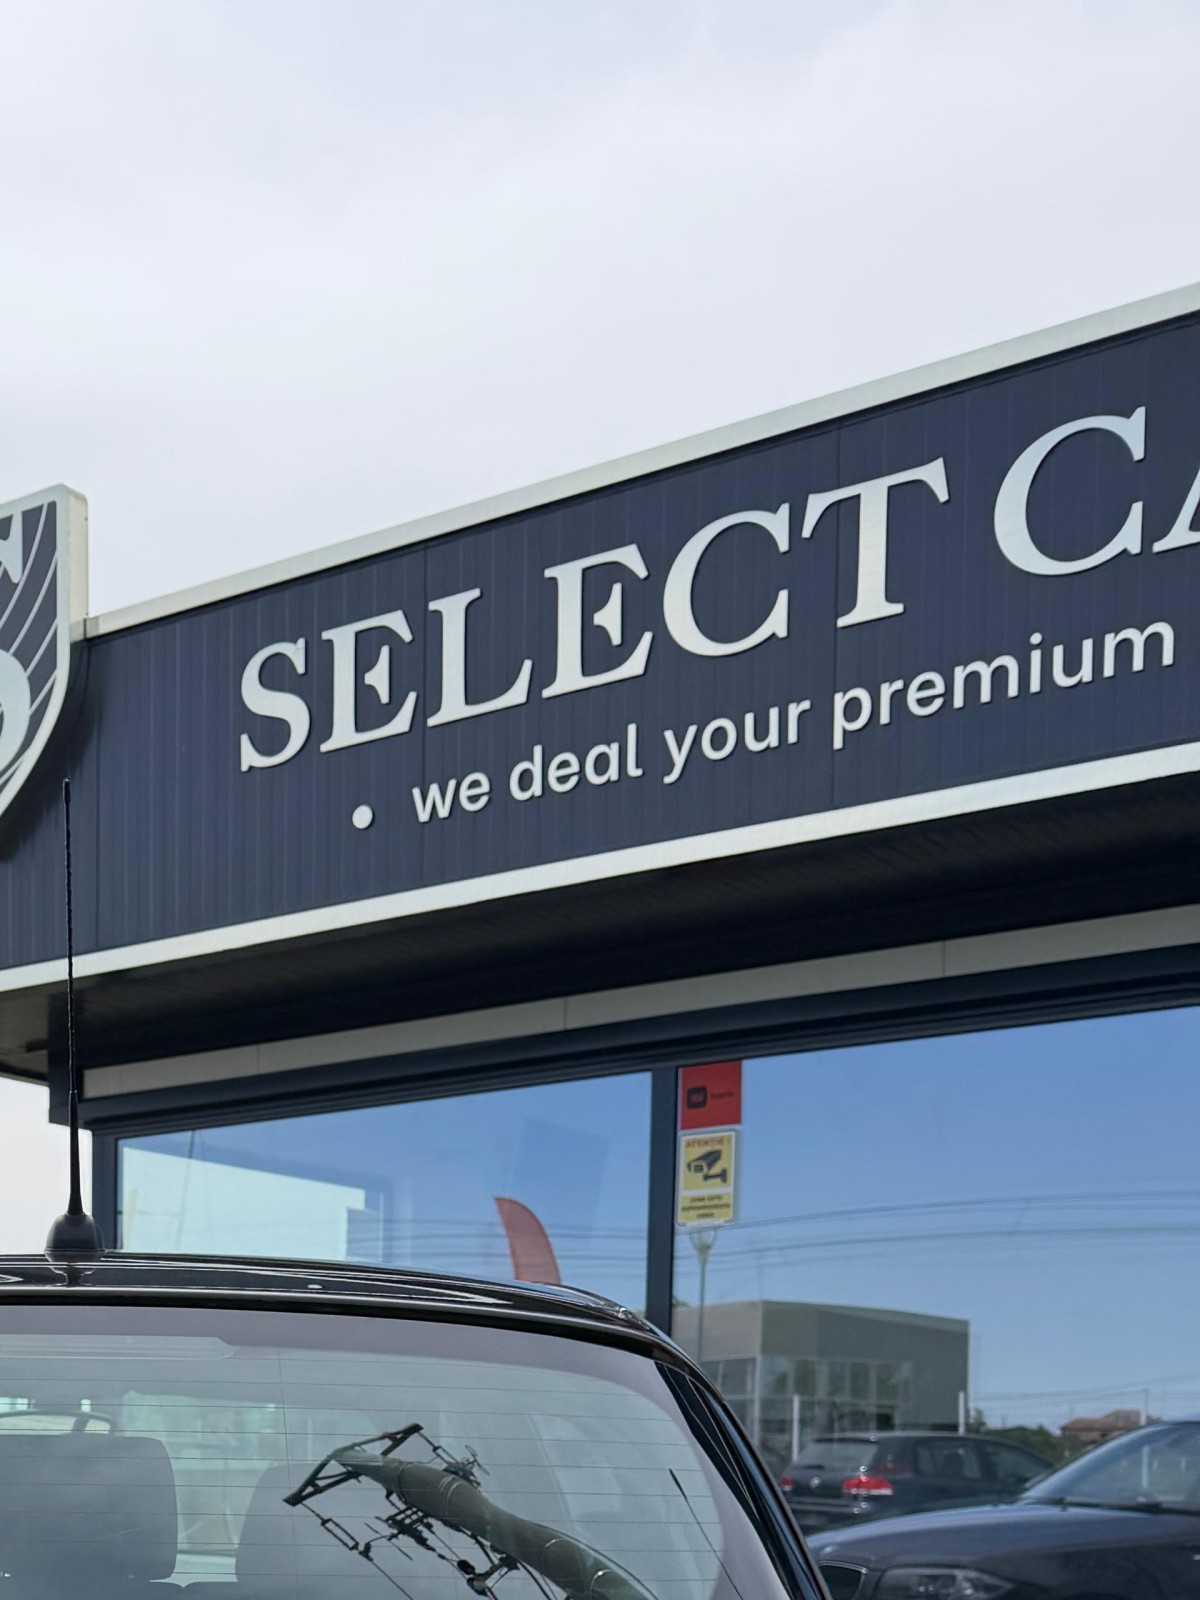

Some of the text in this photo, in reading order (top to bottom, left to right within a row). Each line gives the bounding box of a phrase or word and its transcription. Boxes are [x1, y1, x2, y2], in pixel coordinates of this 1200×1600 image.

[238, 456, 950, 773] SELECT
[411, 620, 1176, 824] we deal your premium
